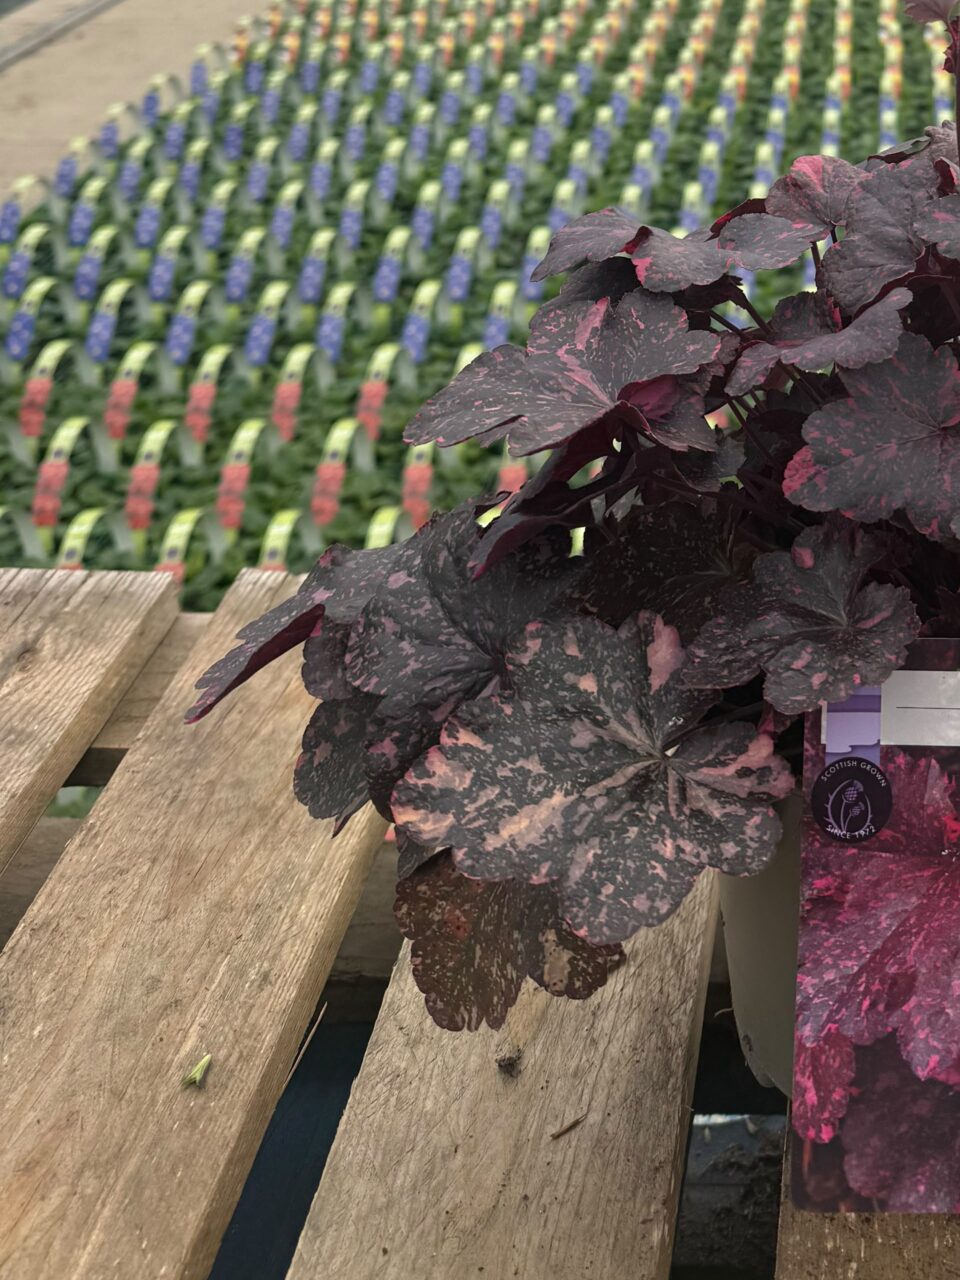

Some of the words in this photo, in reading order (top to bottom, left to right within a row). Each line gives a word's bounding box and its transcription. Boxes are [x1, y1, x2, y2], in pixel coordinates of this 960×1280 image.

[821, 760, 857, 782] SCOTTISH
[860, 761, 887, 787] GROWN
[826, 824, 851, 839] SINCE
[855, 825, 876, 839] 1972
